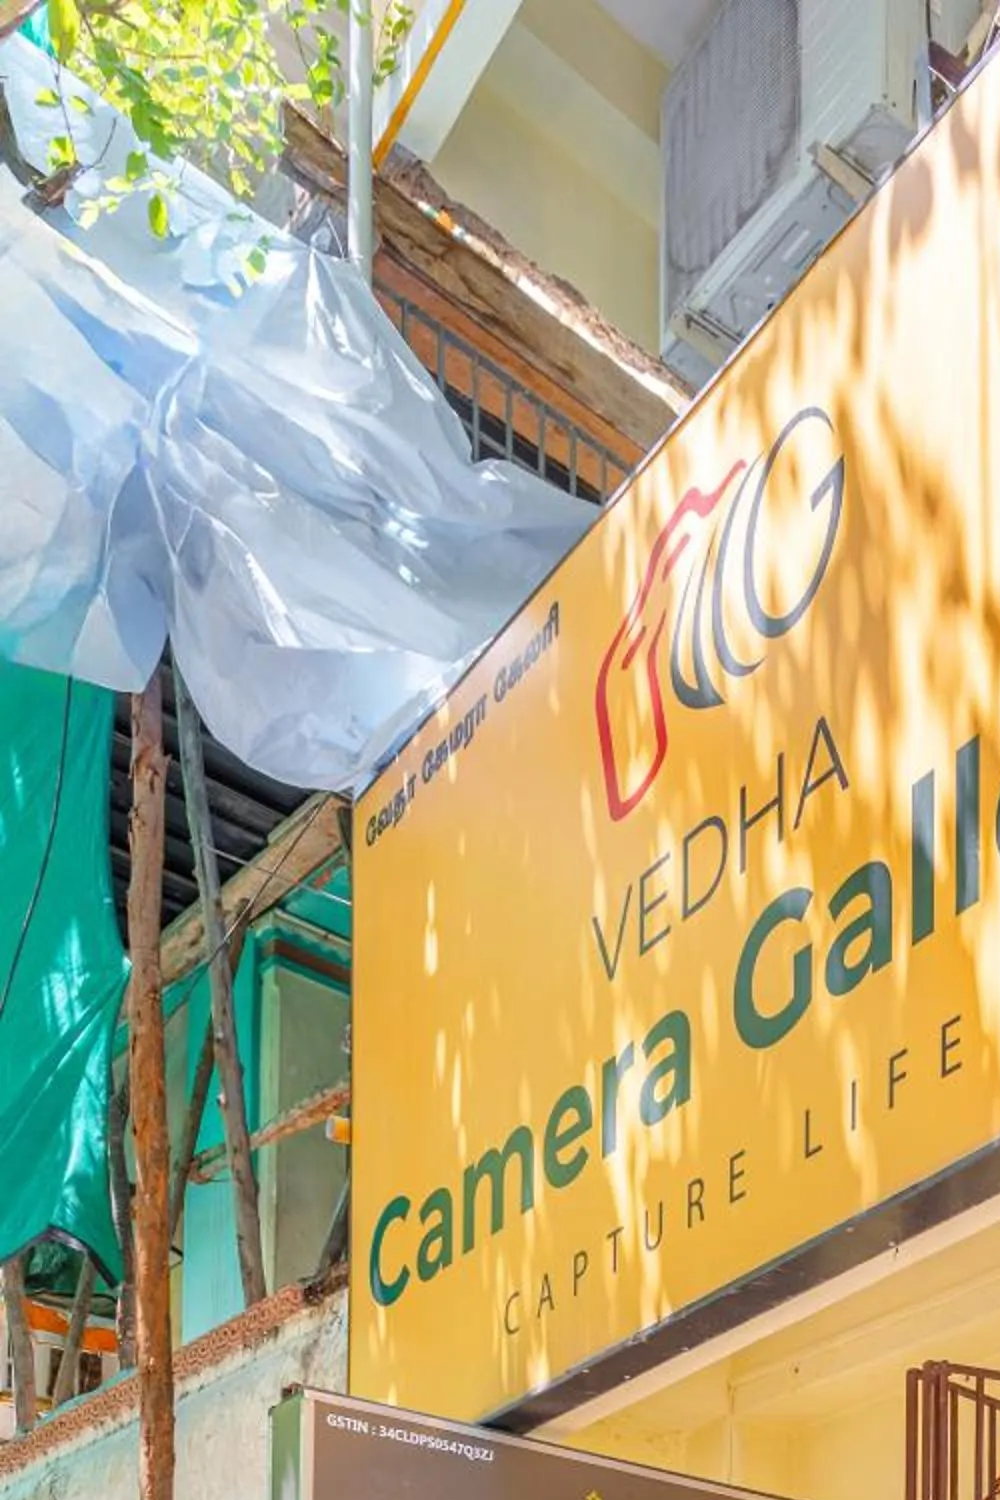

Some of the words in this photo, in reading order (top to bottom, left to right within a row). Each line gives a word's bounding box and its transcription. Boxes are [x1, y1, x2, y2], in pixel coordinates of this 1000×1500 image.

[592, 716, 849, 981] VEDHA
[369, 1010, 691, 1307] Camera
[504, 1151, 747, 1336] CAPTURE
[805, 1016, 962, 1159] LIFE
[326, 1413, 369, 1434] GSTIN
